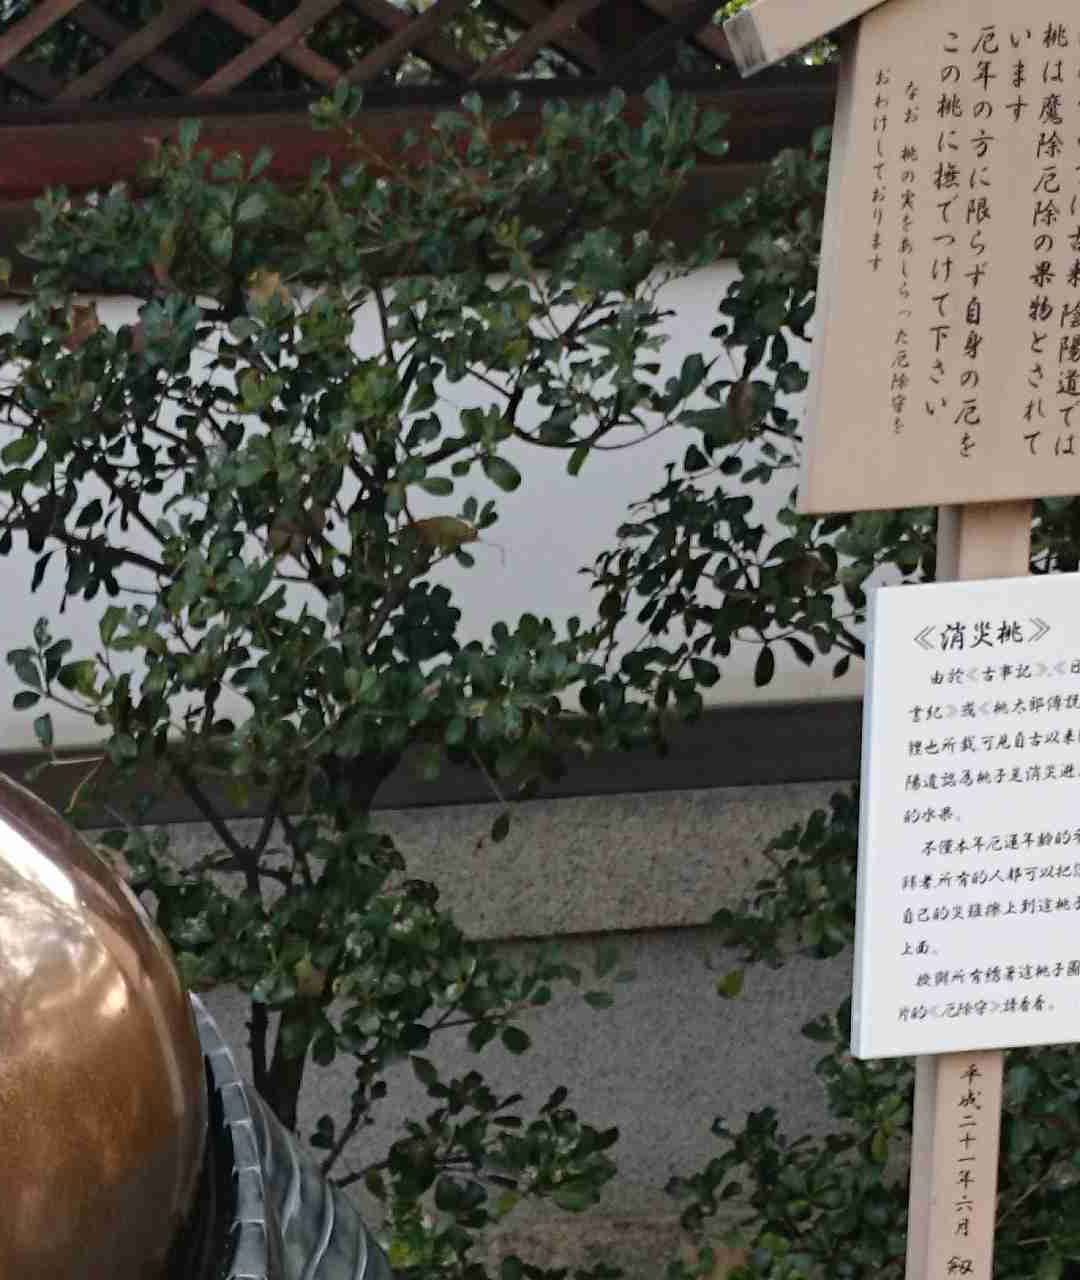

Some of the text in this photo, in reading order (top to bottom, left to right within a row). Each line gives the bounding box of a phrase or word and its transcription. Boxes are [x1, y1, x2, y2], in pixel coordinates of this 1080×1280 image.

[1005, 28, 1031, 122] います
[924, 31, 963, 417] この桃に撫でつけて下さい
[954, 25, 999, 457] 厄年の方に限らず自身の厄を
[955, 1063, 982, 1237] 平成二十一年六月
